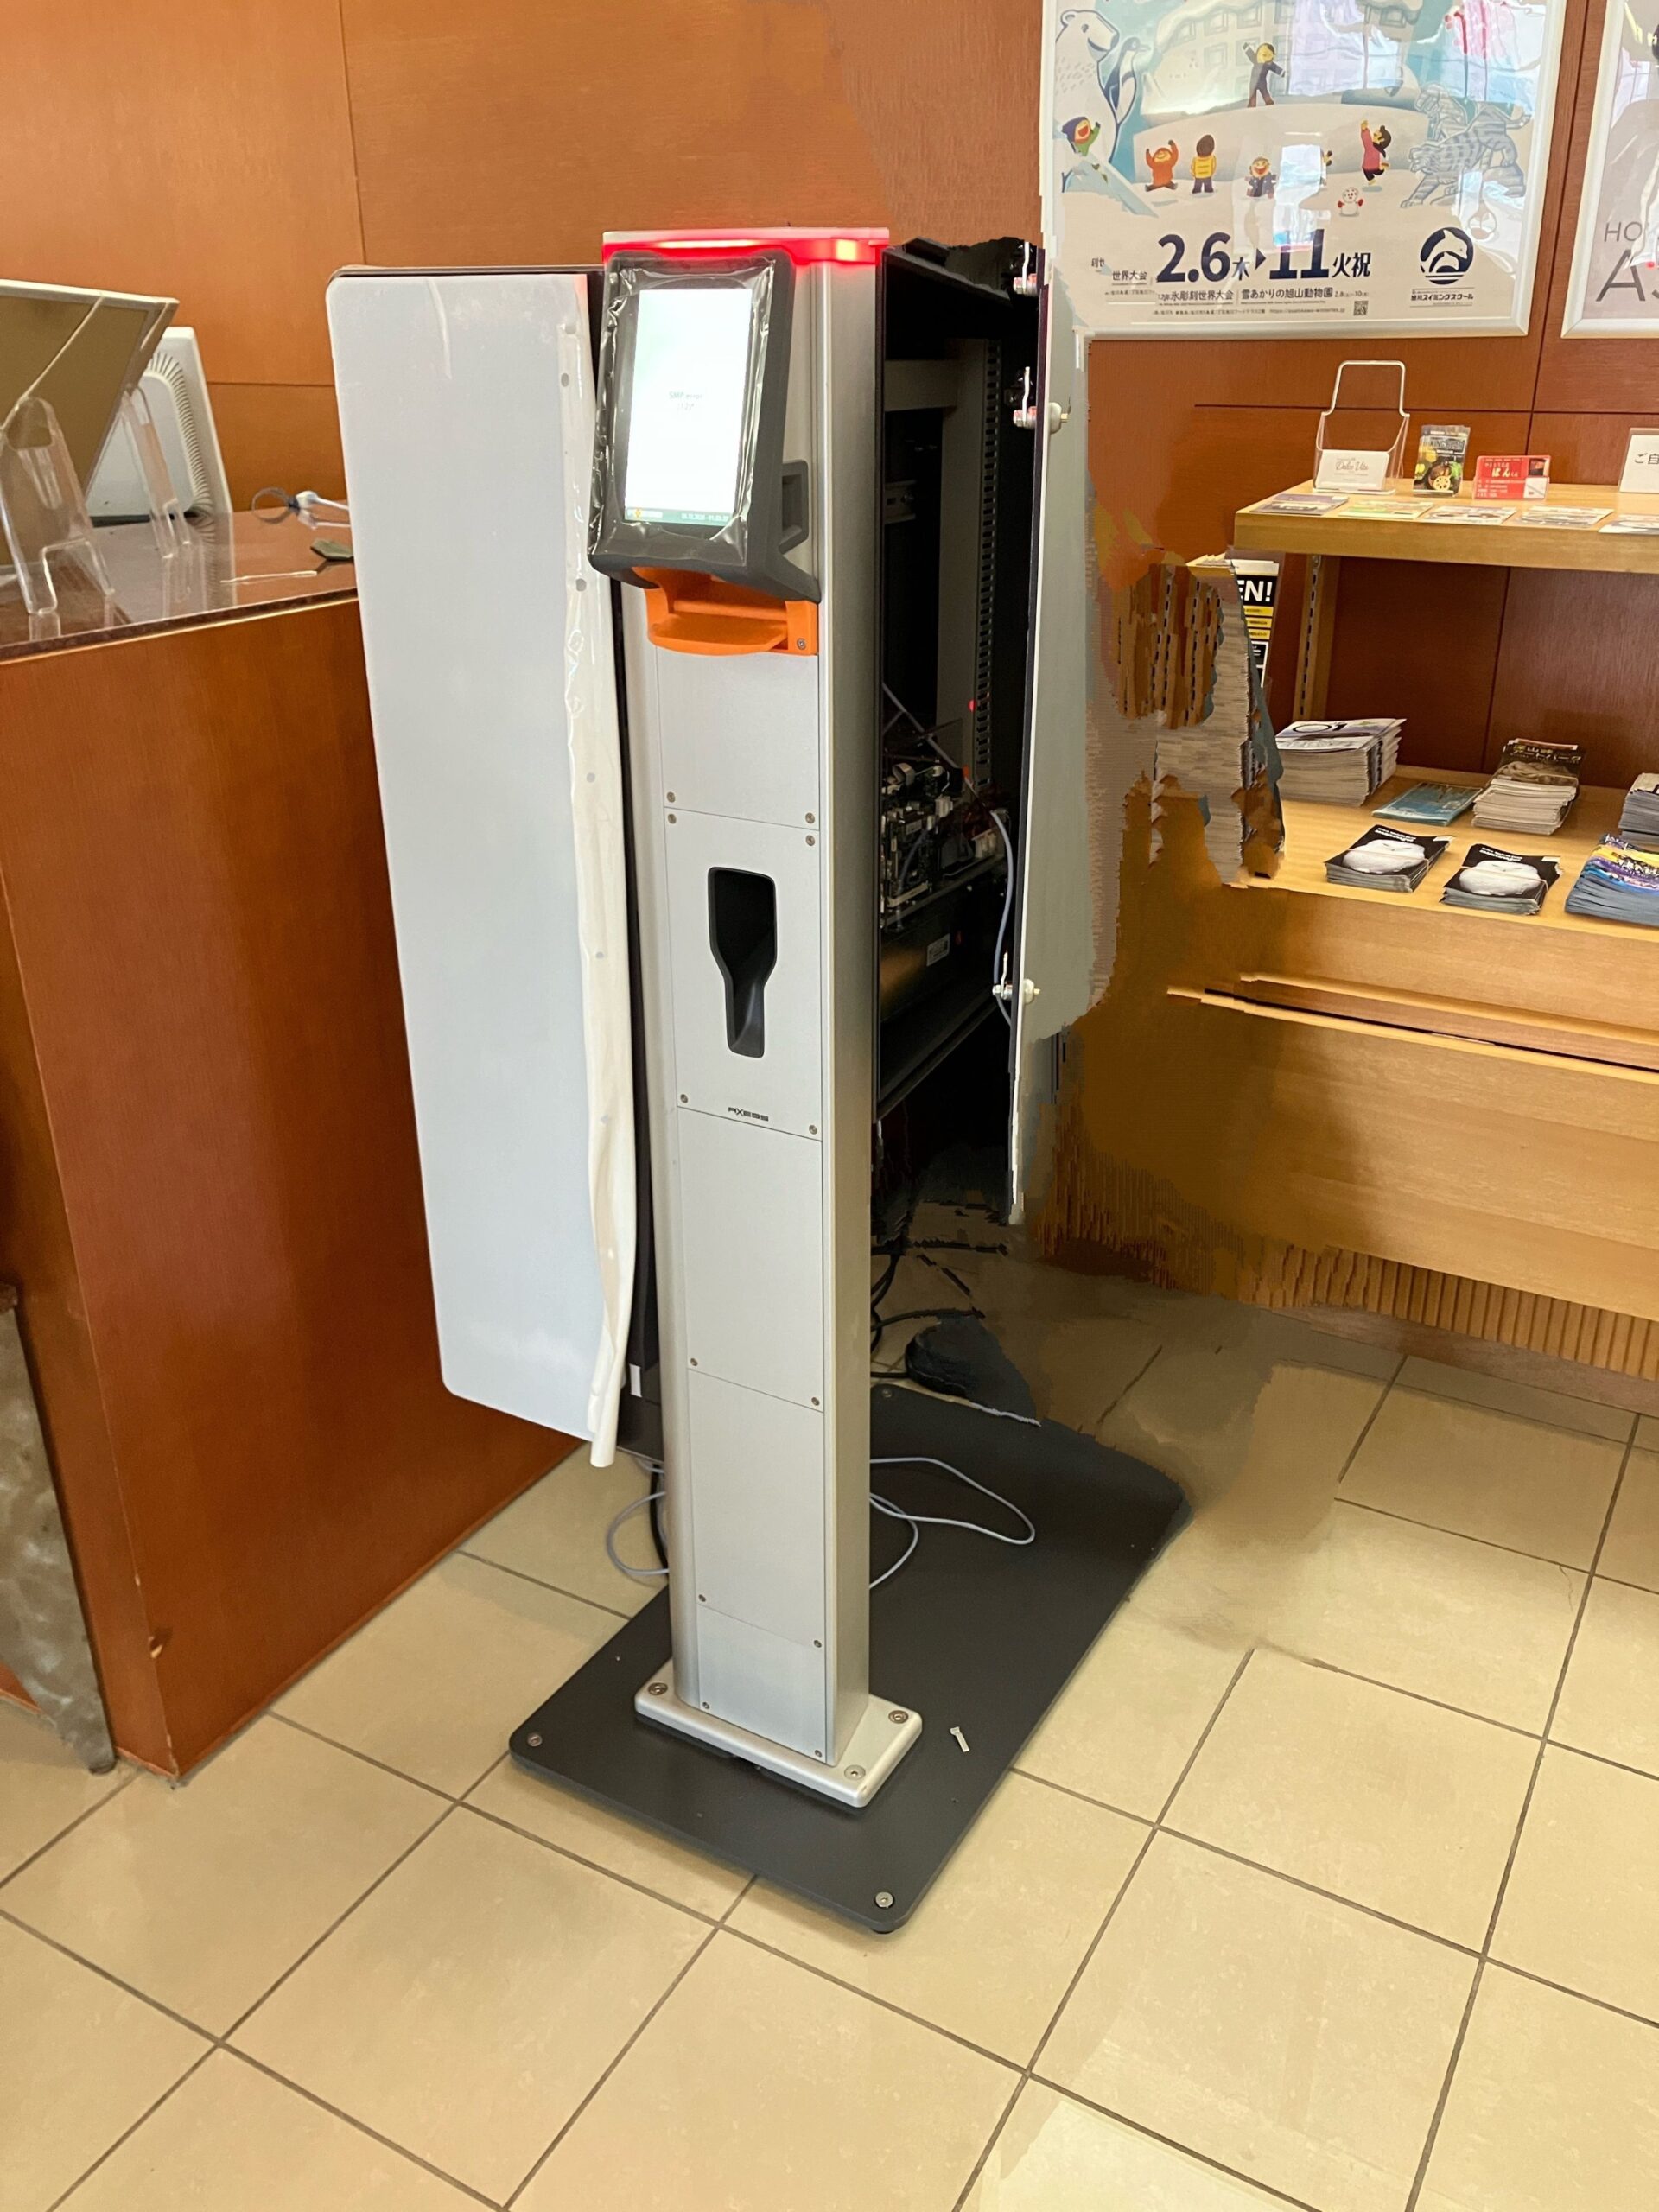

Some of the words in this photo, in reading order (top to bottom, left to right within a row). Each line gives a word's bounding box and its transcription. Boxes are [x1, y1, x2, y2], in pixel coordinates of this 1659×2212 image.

[1595, 249, 1659, 302] A
[1241, 287, 1333, 299] 雪あかりの旭山動物園
